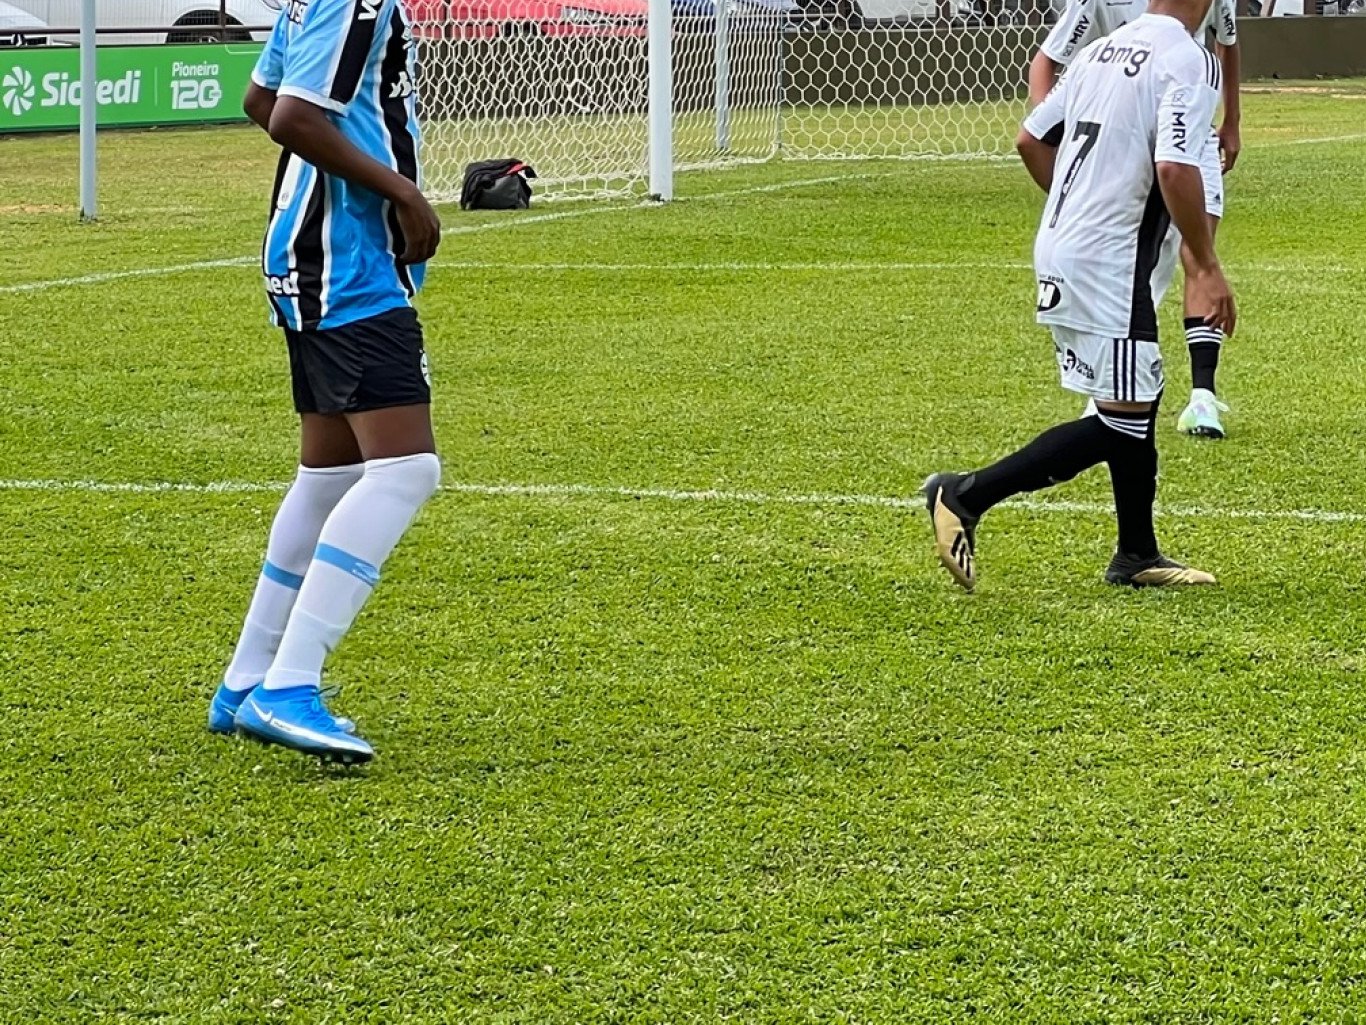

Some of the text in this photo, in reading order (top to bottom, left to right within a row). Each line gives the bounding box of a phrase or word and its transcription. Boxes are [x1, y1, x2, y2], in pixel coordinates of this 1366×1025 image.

[1068, 14, 1091, 46] MRV
[171, 60, 220, 78] Pioneira
[1098, 39, 1151, 77] bmg
[40, 70, 142, 107] Sicedi
[1171, 111, 1187, 153] MRV
[1048, 120, 1102, 229] 7
